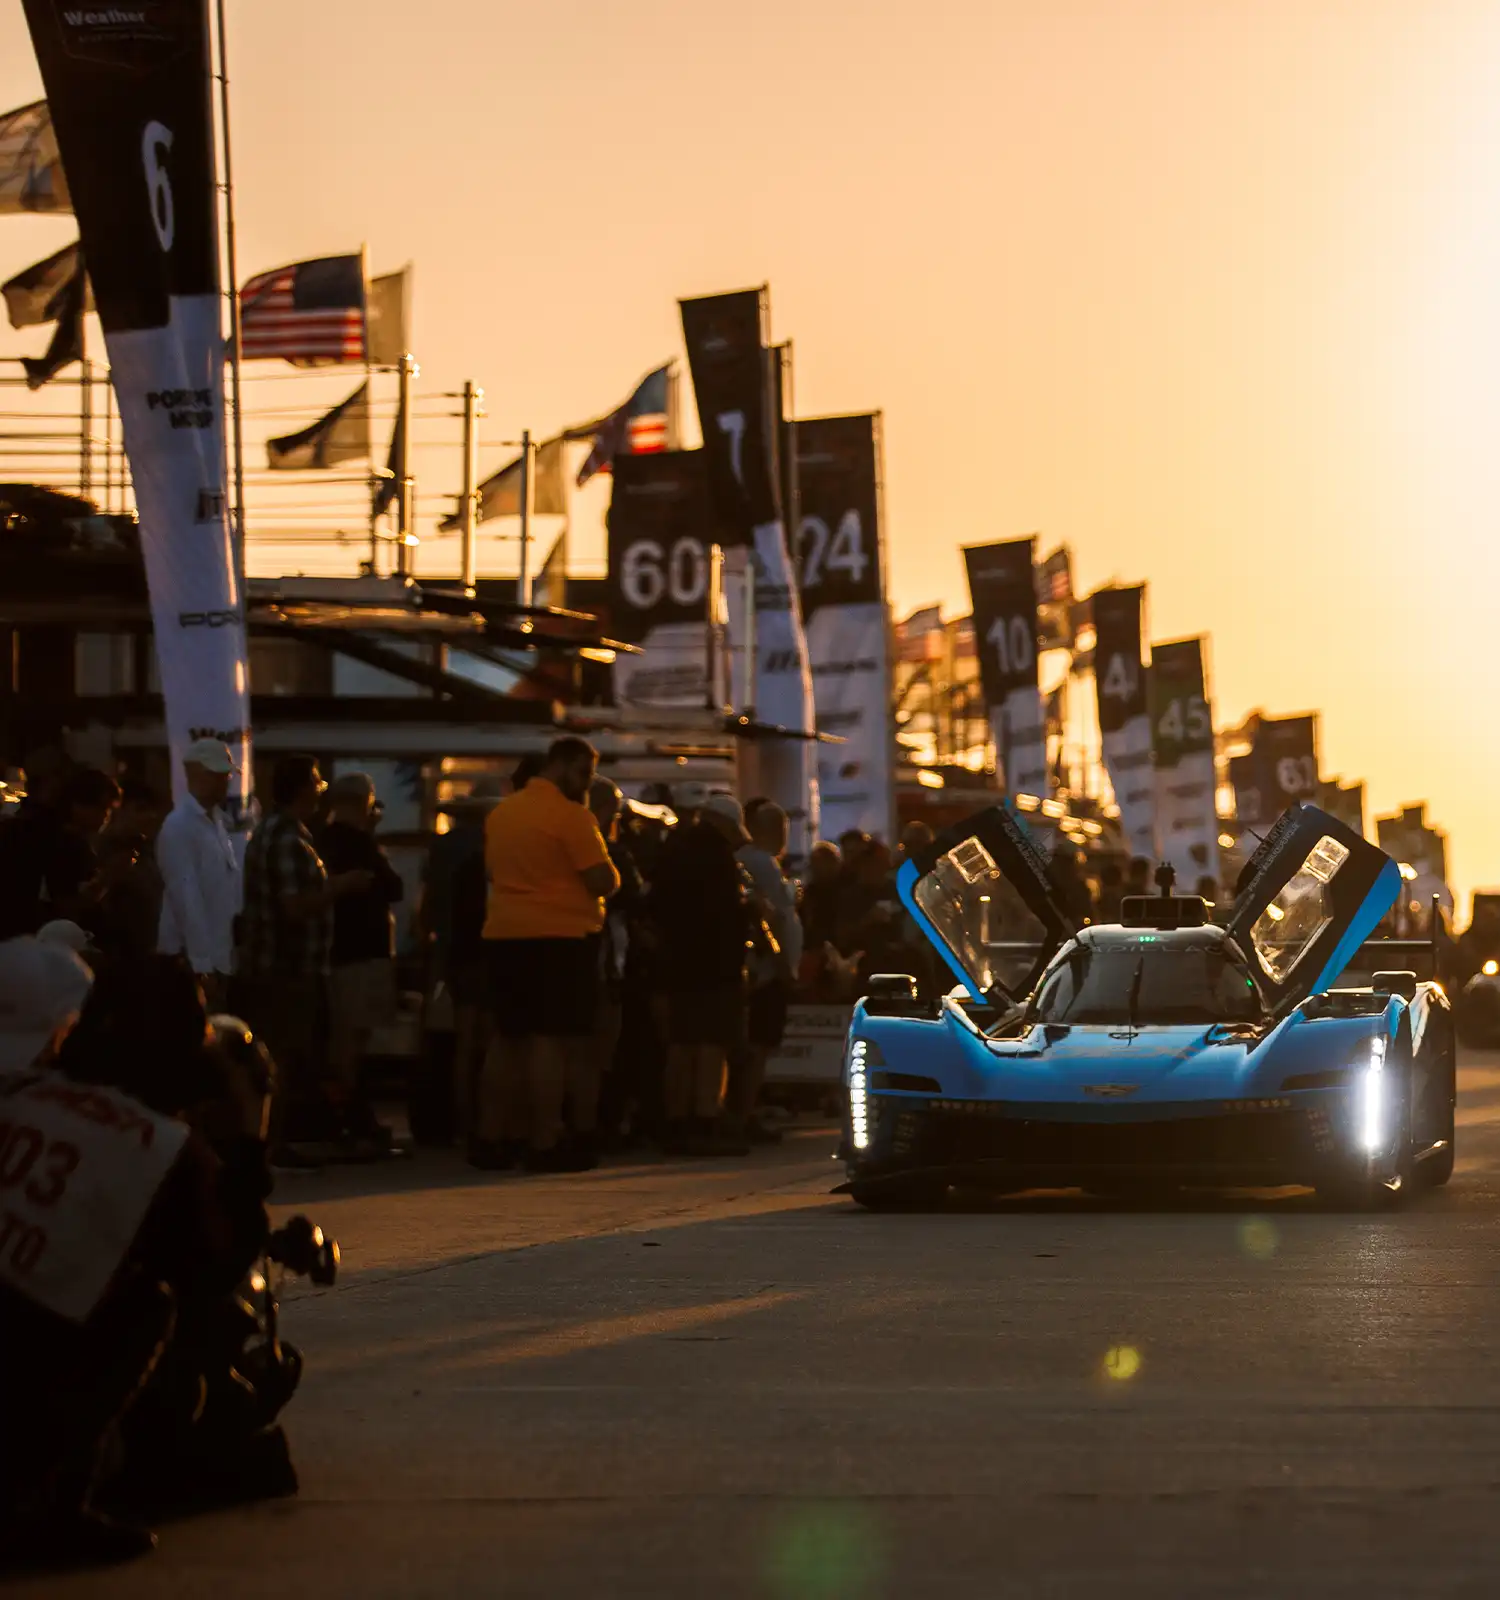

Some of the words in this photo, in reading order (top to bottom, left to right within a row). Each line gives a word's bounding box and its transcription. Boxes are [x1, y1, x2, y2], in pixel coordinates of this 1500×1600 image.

[141, 119, 174, 253] 6
[620, 536, 706, 609] 60
[986, 614, 1033, 674] 10
[1158, 696, 1209, 743] 45
[1089, 942, 1224, 955] ADILLAC
